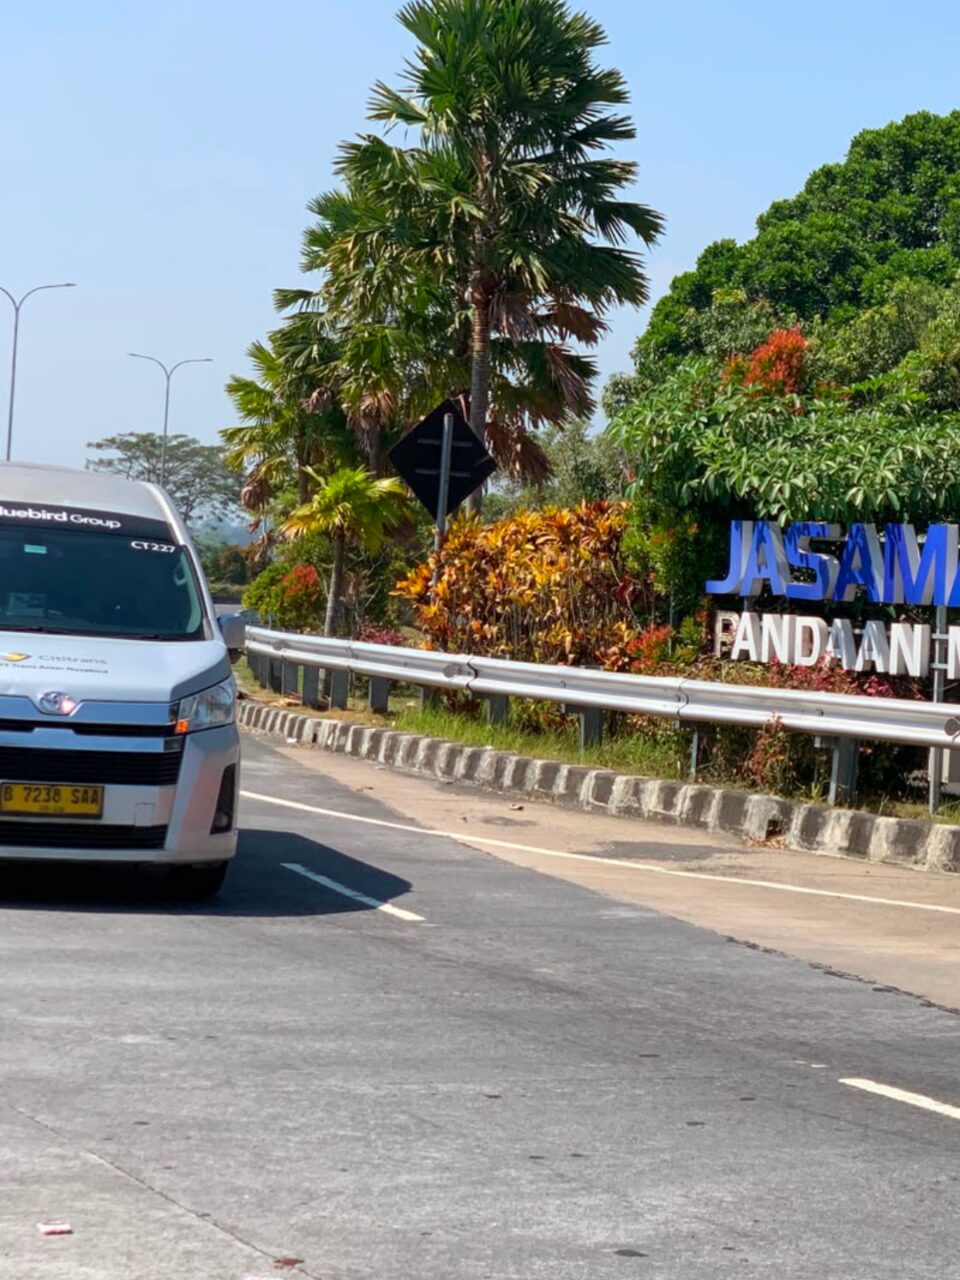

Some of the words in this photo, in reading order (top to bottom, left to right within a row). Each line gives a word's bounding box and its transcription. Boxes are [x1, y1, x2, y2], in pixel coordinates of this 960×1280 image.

[70, 513, 122, 529] Group
[131, 541, 176, 554] CT227
[714, 610, 930, 678] PANDAAN
[3, 786, 13, 802] B
[23, 787, 61, 804] 7238
[71, 788, 99, 805] SAA
